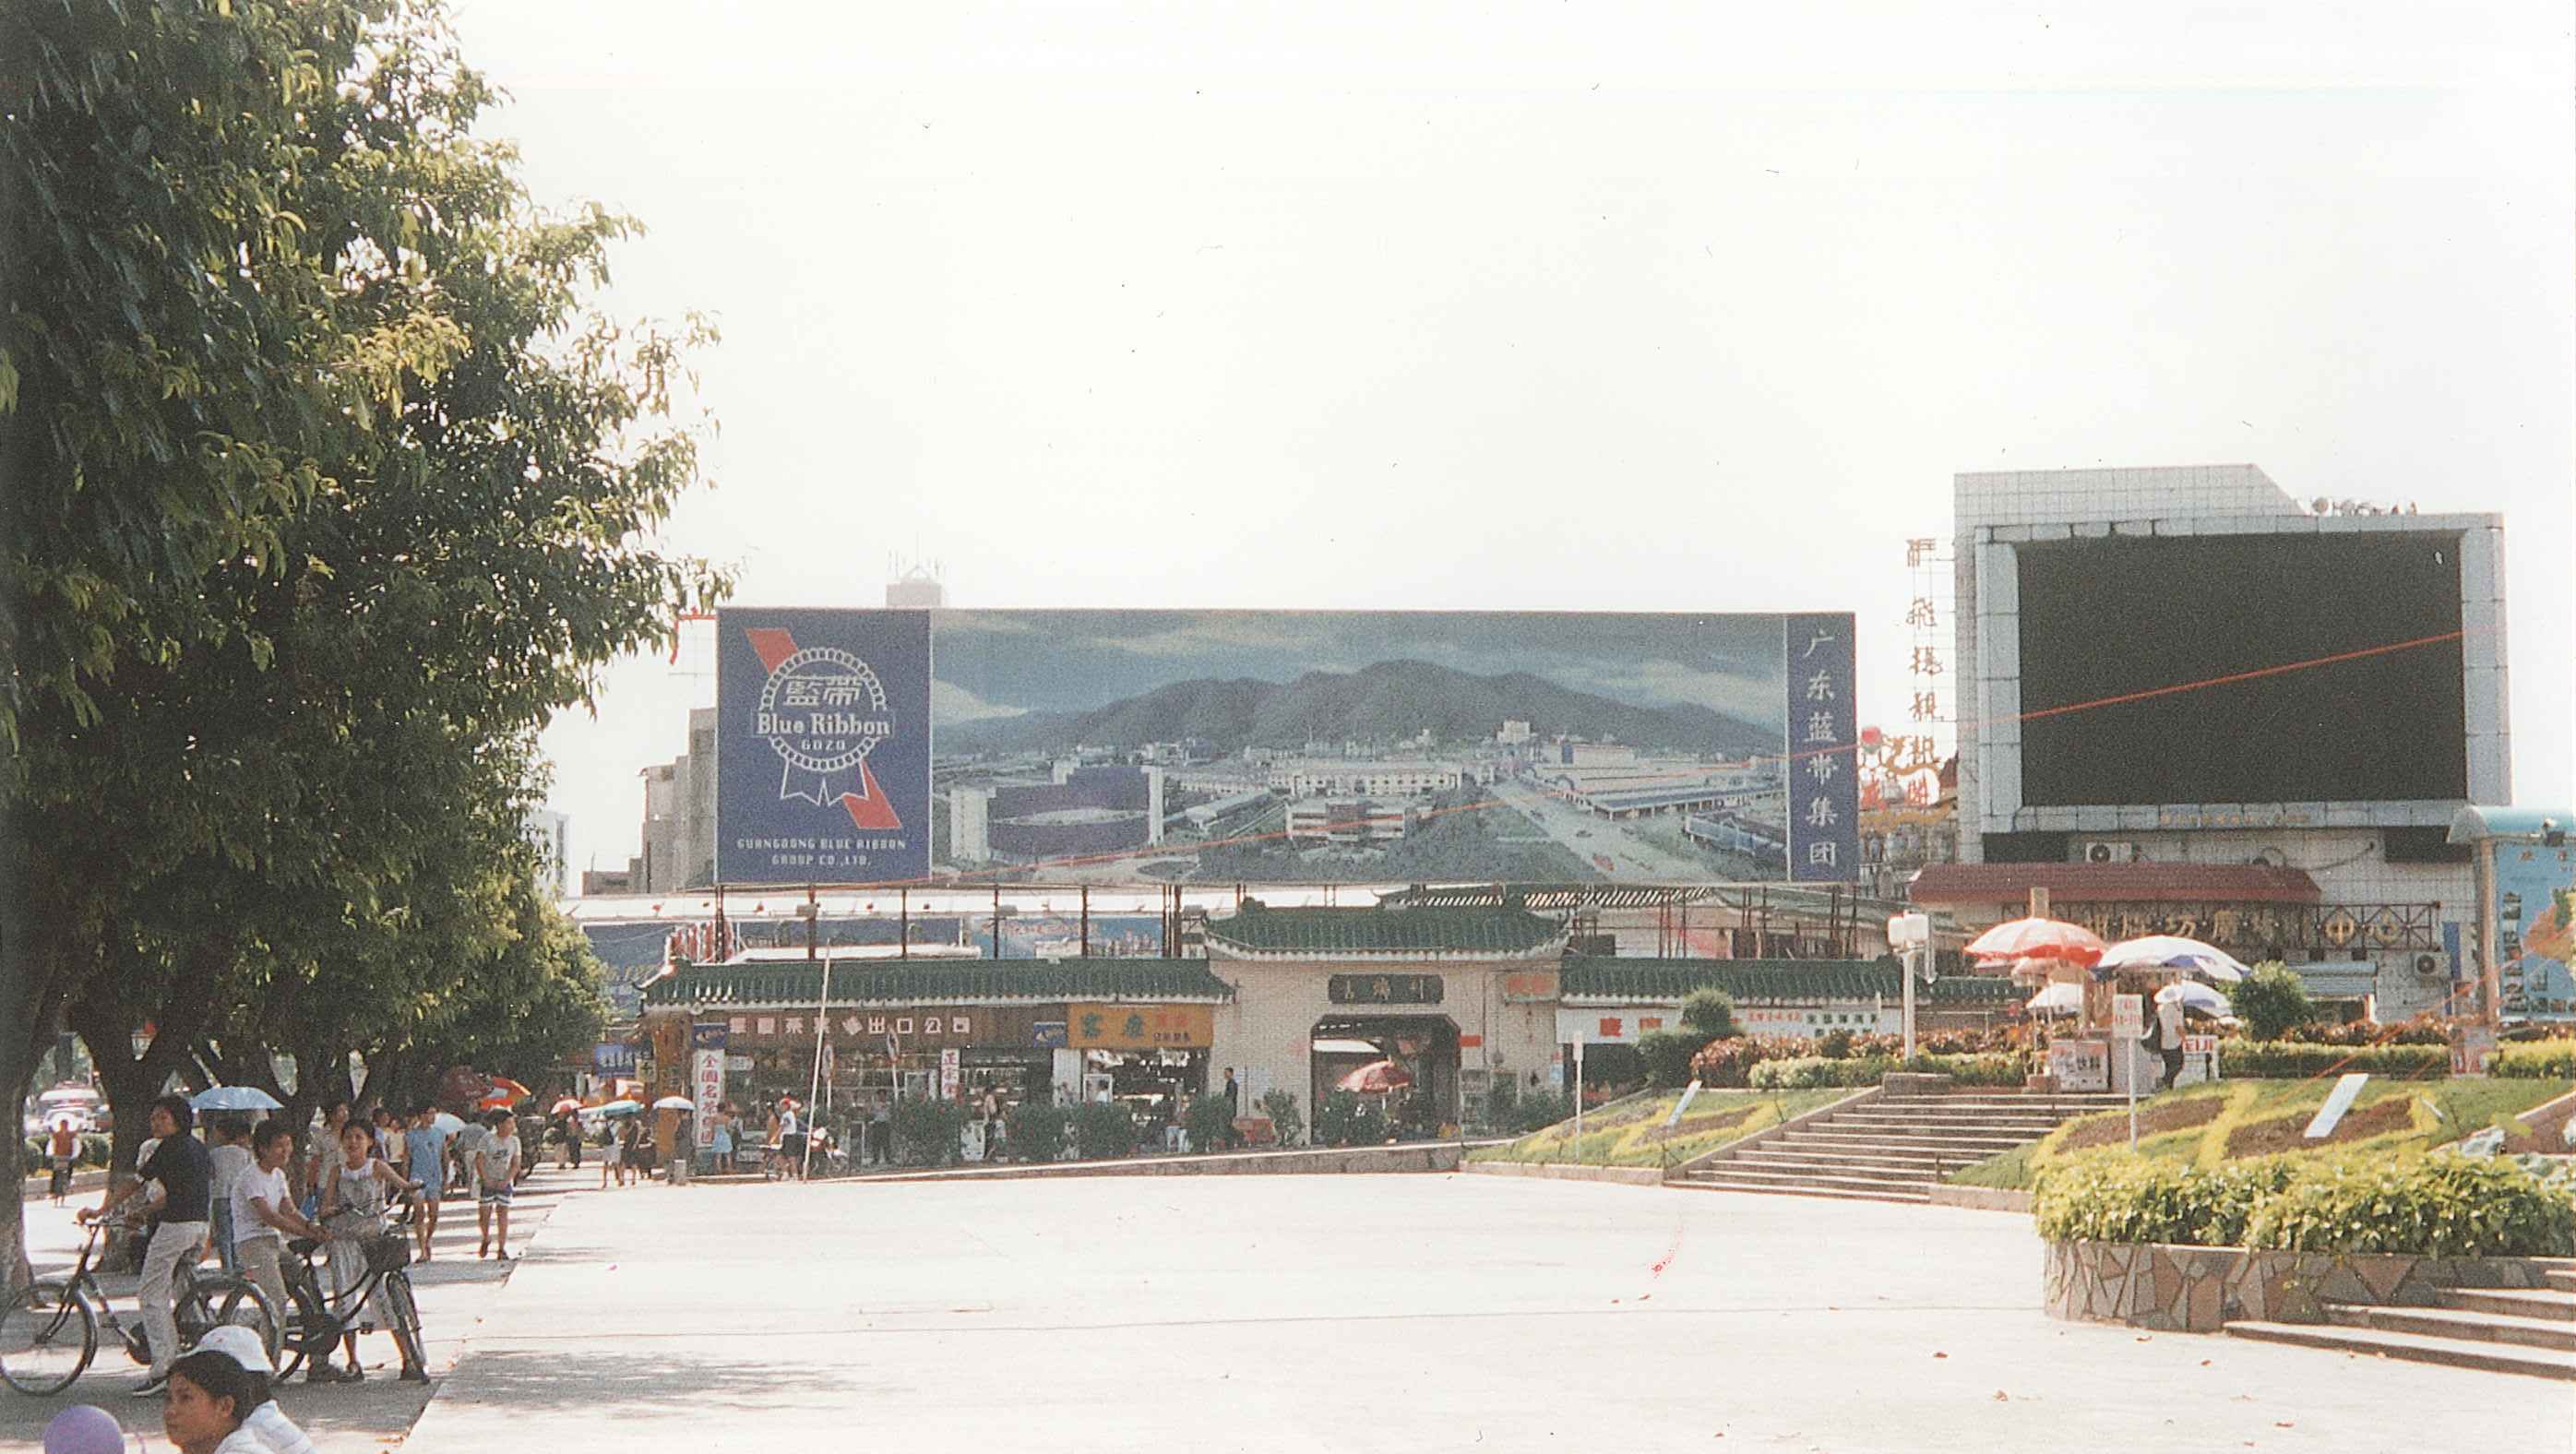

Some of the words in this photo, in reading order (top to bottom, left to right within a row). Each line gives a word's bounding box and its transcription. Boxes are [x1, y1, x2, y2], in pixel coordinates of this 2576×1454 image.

[757, 712, 805, 734] Blue
[810, 712, 890, 735] Ribbon
[1803, 629, 1839, 867] 广东蓝带集团
[737, 839, 816, 850] GUANGDONG
[820, 839, 852, 850] BLUE
[856, 839, 906, 850] RIBBON
[771, 854, 814, 865] GROUP
